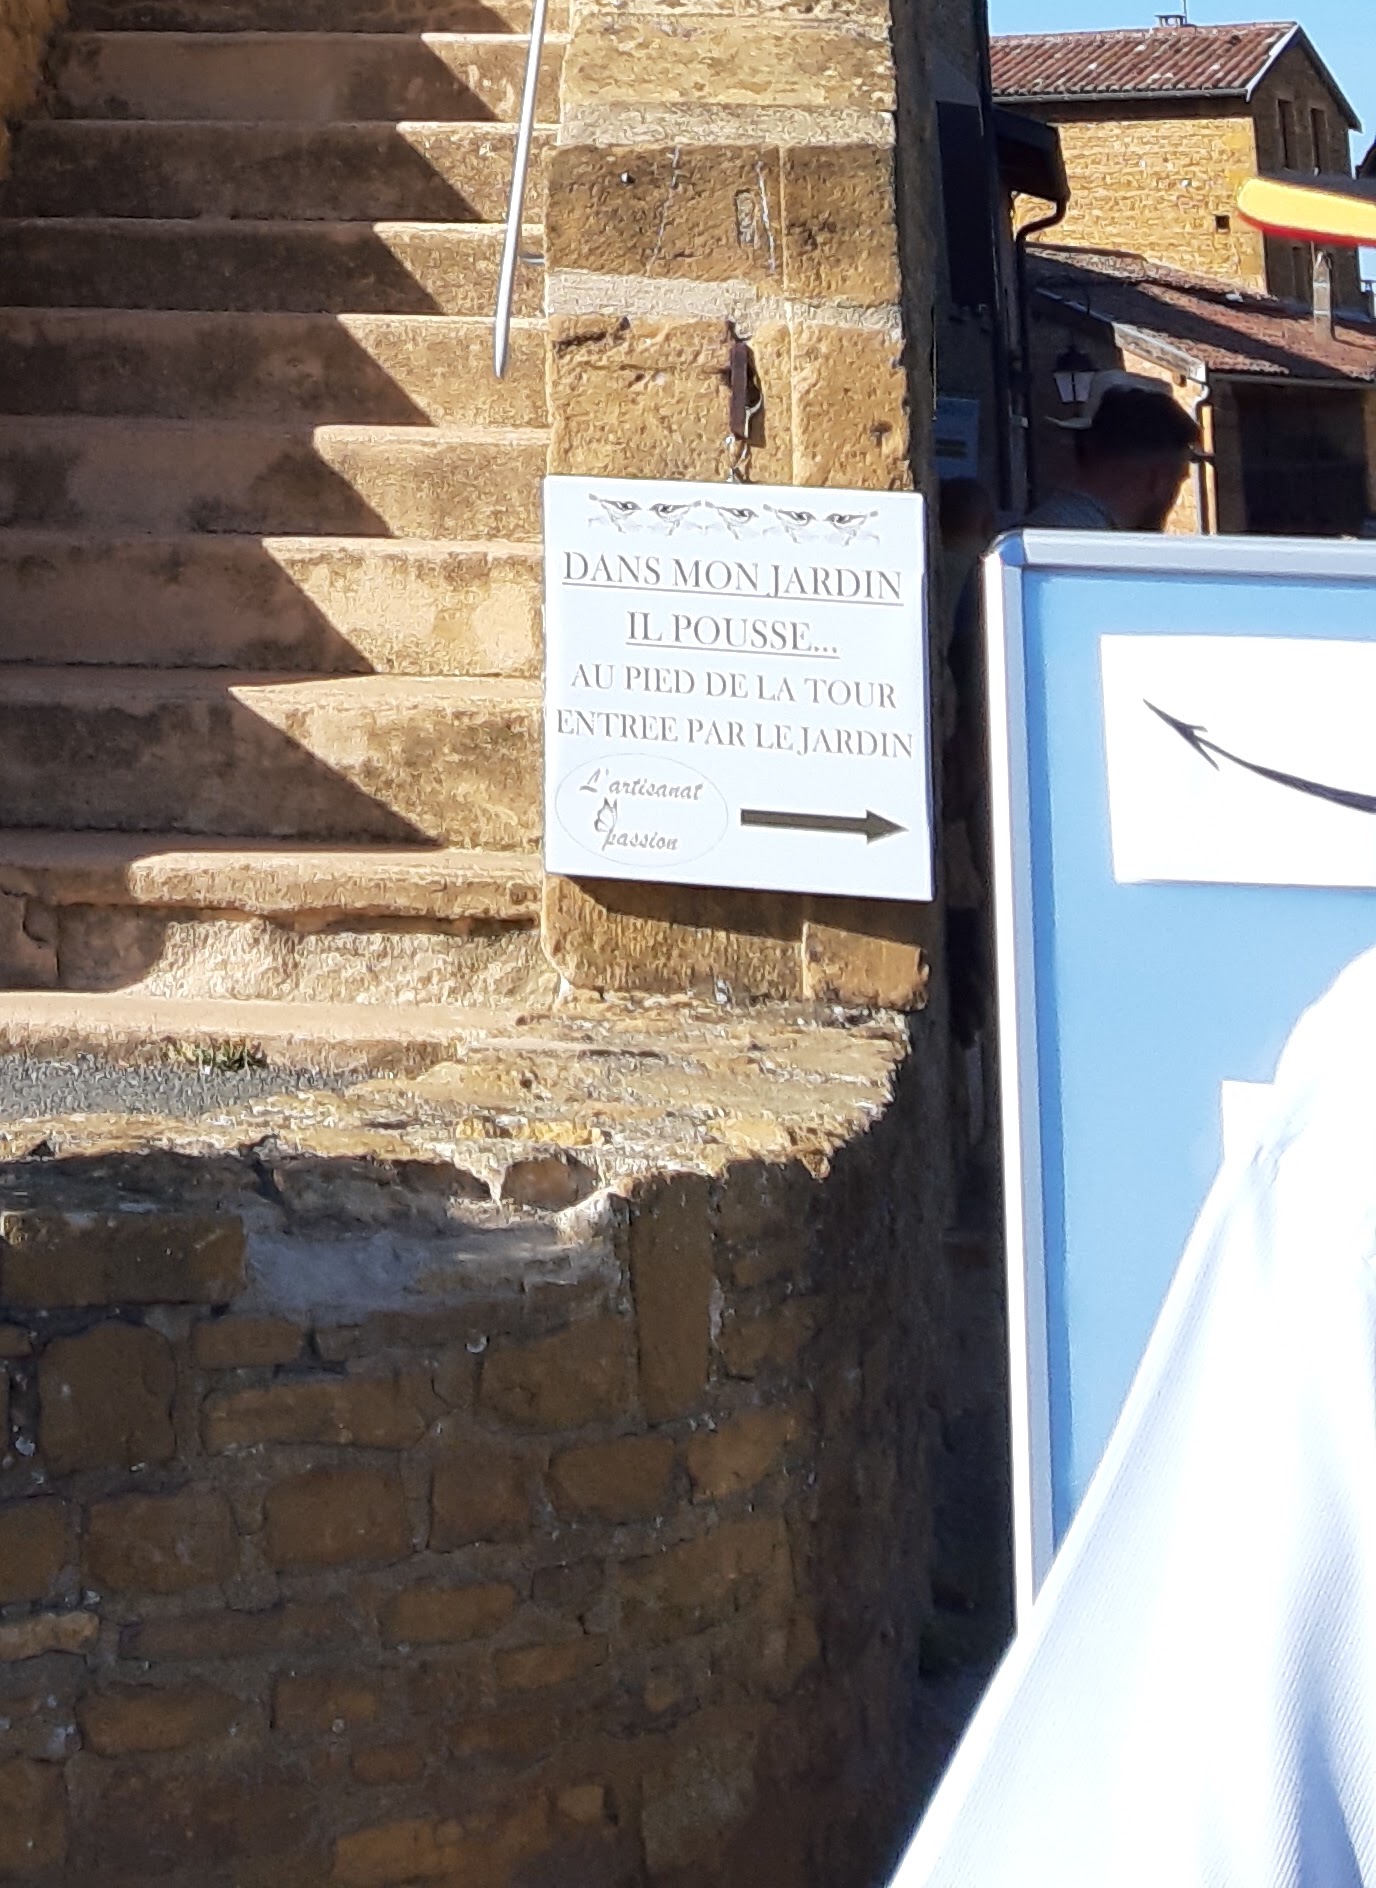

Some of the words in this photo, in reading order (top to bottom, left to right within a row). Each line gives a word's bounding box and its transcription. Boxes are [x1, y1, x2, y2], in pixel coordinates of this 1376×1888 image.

[562, 550, 661, 586] DANS
[672, 558, 759, 593] MON
[767, 564, 902, 600] JARDIN
[626, 611, 663, 642] IL
[672, 613, 838, 655] POUSSE...
[570, 664, 614, 691] AU
[625, 666, 695, 695] PIED
[706, 671, 748, 699] DE
[757, 676, 796, 703] LA
[804, 678, 897, 709] TOUR
[556, 709, 678, 743] ENTREE
[687, 719, 745, 747] PAR
[756, 724, 793, 750] LE
[796, 727, 913, 758] JARDIN
[579, 767, 704, 801] L'artisanat
[601, 829, 678, 852] passion
